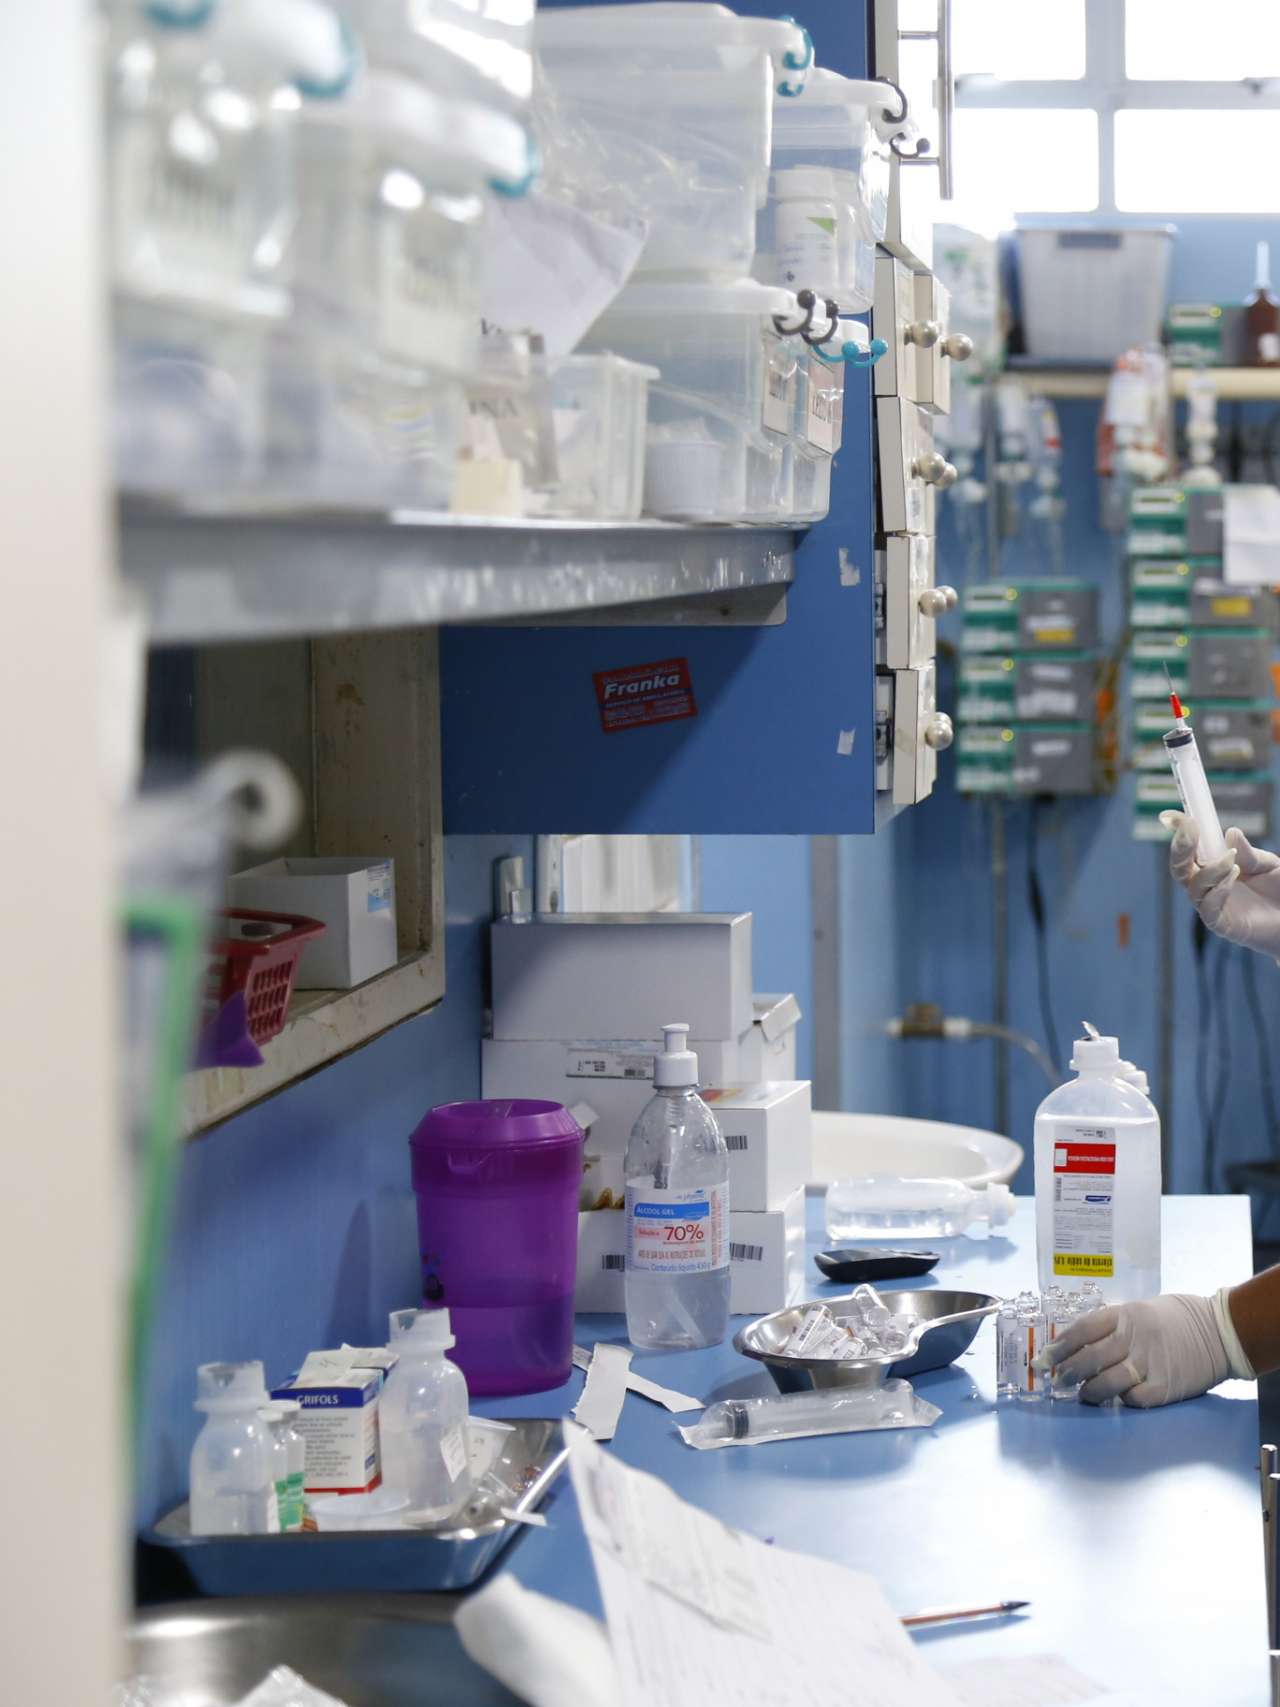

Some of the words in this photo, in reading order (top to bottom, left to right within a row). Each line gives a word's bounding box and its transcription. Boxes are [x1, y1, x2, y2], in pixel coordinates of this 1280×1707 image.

[604, 674, 681, 700] Franka
[664, 1224, 704, 1241] 70%
[296, 1394, 339, 1405] GRIFOLS
